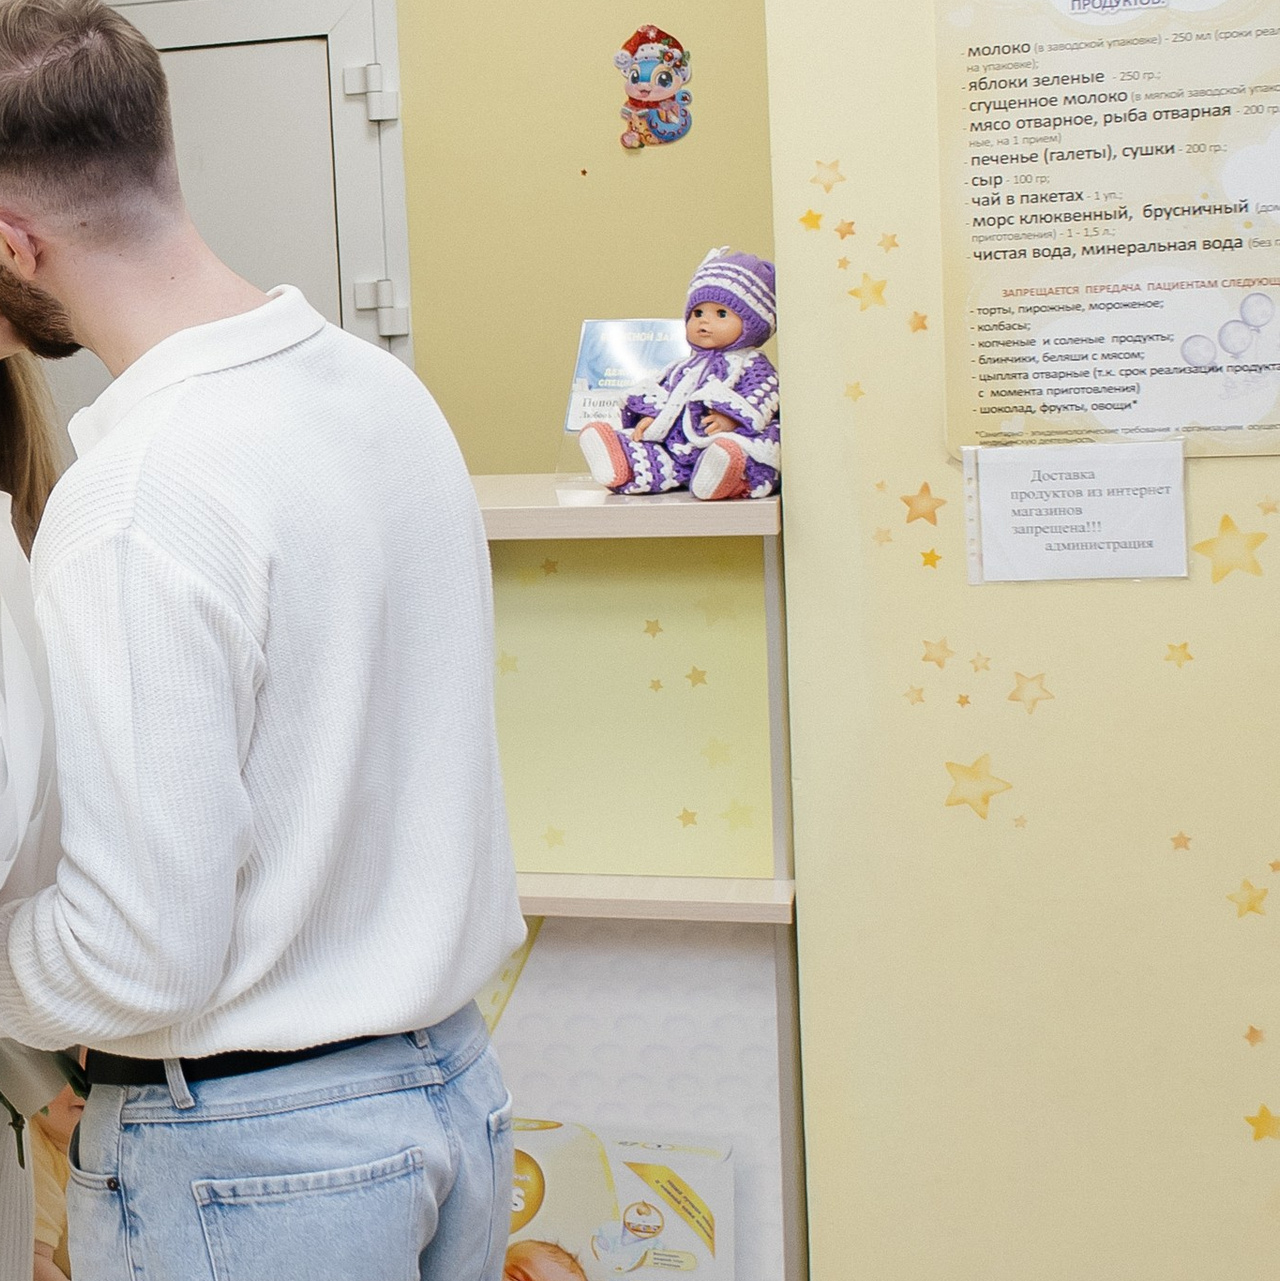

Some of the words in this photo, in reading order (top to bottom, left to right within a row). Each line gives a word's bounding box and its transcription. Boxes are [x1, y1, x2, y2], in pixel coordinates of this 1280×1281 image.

[967, 43, 1031, 57] молоко
[1047, 38, 1104, 52] заводской
[1106, 34, 1162, 48] упаковке)
[1171, 32, 1193, 43] 250
[1195, 33, 1212, 41] мл
[1214, 29, 1252, 41] (сроки
[967, 64, 980, 72] на
[982, 58, 1039, 73] упаковке);
[969, 76, 1028, 91] яблоки
[1032, 72, 1105, 87] зеленые
[1120, 71, 1140, 81] 250
[969, 96, 1058, 113] сгущенное
[1063, 91, 1128, 105] молоко
[1144, 89, 1184, 100] мягкой
[1187, 85, 1246, 97] заводской
[970, 120, 1011, 131] мясо
[1016, 114, 1098, 129] отварное,
[1103, 108, 1147, 127] рыба
[1152, 105, 1231, 121] отварная
[1243, 105, 1264, 115] 200
[997, 138, 1010, 146] на
[1013, 136, 1019, 145] 1
[1022, 133, 1062, 146] прием)
[971, 152, 1039, 166] печенье
[1044, 144, 1117, 164] (галеты),
[1122, 144, 1175, 159] сушки
[1185, 143, 1206, 154] 200
[971, 175, 1003, 188] сыр
[1013, 174, 1033, 184] 100
[971, 192, 1001, 206] чай
[1006, 195, 1015, 205] в
[1020, 191, 1084, 204] пакетах
[1094, 191, 1100, 200] 1
[972, 215, 1015, 228] морс
[1019, 205, 1133, 224] клюквенный,
[1142, 199, 1249, 220] брусничный
[971, 229, 1057, 243] приготовления)
[973, 248, 1027, 260] чистая
[1032, 246, 1077, 259] вода,
[1081, 240, 1197, 256] минеральная
[1202, 238, 1243, 252] вода
[1002, 286, 1080, 298] ЗАПРЕЩАЕТСЯ
[1085, 283, 1141, 294] ПЕРЕДАЧА
[1147, 280, 1218, 291] ПАЦИЕНТАМ
[977, 306, 1015, 316] торты,
[1018, 303, 1085, 315] пирожные,
[1088, 299, 1164, 312] мороженое;
[977, 321, 1032, 332] колбасы;
[978, 337, 1037, 348] копченые
[1042, 338, 1051, 346] и
[1053, 335, 1105, 346] соленые
[1111, 333, 1175, 344] продукты;
[978, 354, 1039, 365] блинчики,
[1042, 352, 1089, 362] беляши
[1091, 353, 1098, 361] с
[1100, 351, 1145, 361] мясом;
[979, 372, 1029, 382] цыплята
[1032, 370, 1090, 381] отварные
[1119, 368, 1147, 378] срок
[1149, 365, 1224, 377] реализации
[978, 390, 984, 398] с
[990, 387, 1043, 397] момента
[1046, 382, 1140, 397] приготовления)
[980, 403, 1036, 414] шоколад,
[1039, 402, 1088, 414] фрукты,
[1030, 470, 1096, 483] Доставка
[1010, 489, 1083, 502] продуктов
[1087, 489, 1103, 497] из
[1106, 485, 1172, 499] интернет
[1010, 506, 1083, 517] магазинов
[1011, 521, 1102, 537] запрещена!!!
[1045, 540, 1154, 552] администрация
